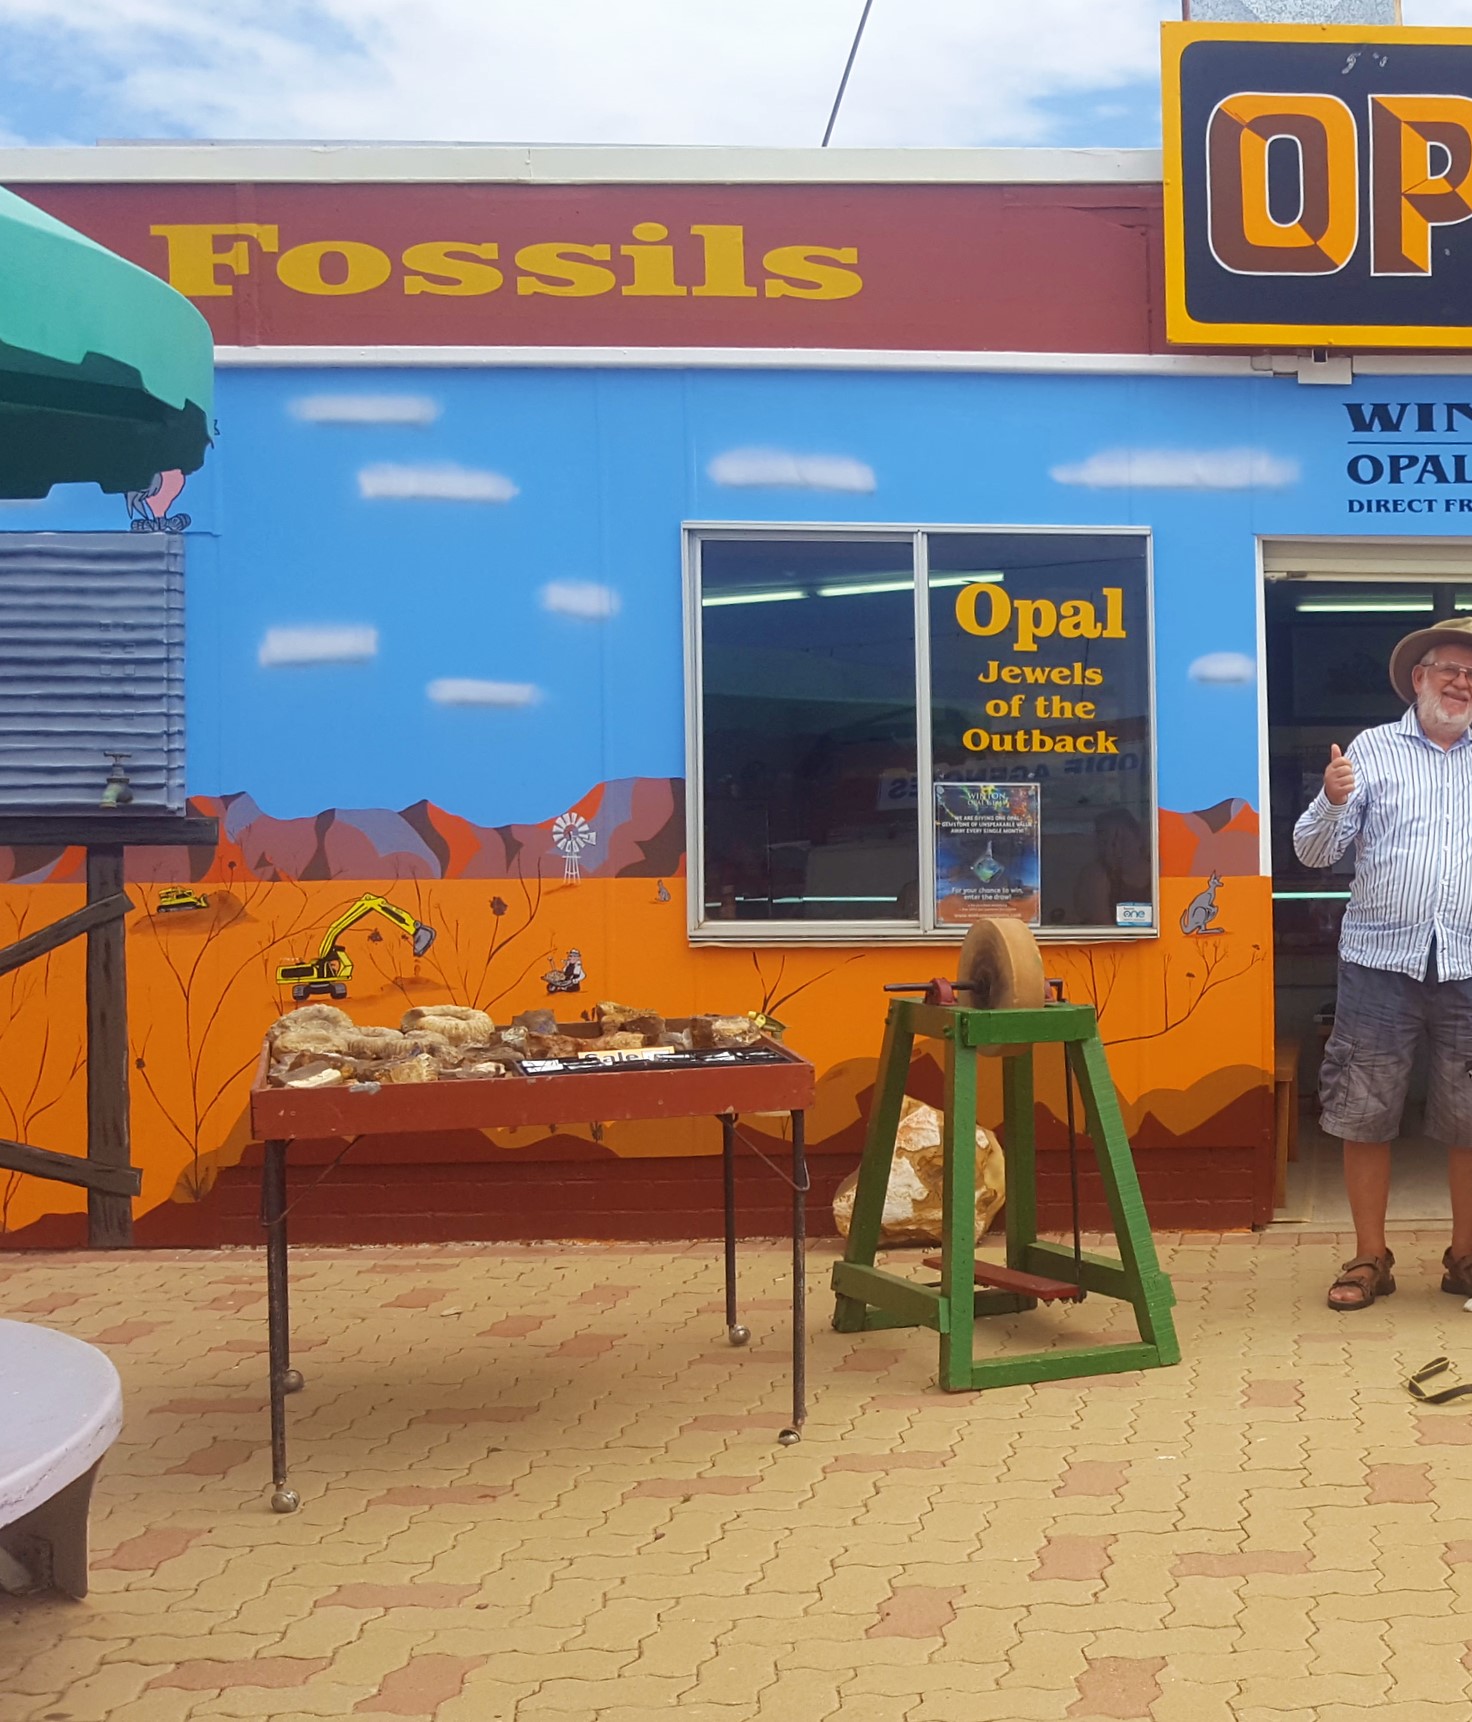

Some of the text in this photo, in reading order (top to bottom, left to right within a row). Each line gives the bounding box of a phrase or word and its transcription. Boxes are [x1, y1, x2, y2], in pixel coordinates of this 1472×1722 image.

[150, 223, 863, 300] Fossils
[1348, 498, 1436, 513] DIRECT
[955, 582, 1127, 652] Opal
[979, 660, 1104, 686] Jewels
[985, 694, 1096, 720] of the
[962, 728, 1119, 754] Outback
[968, 792, 1006, 800] WINTON
[584, 1051, 639, 1063] Sale
